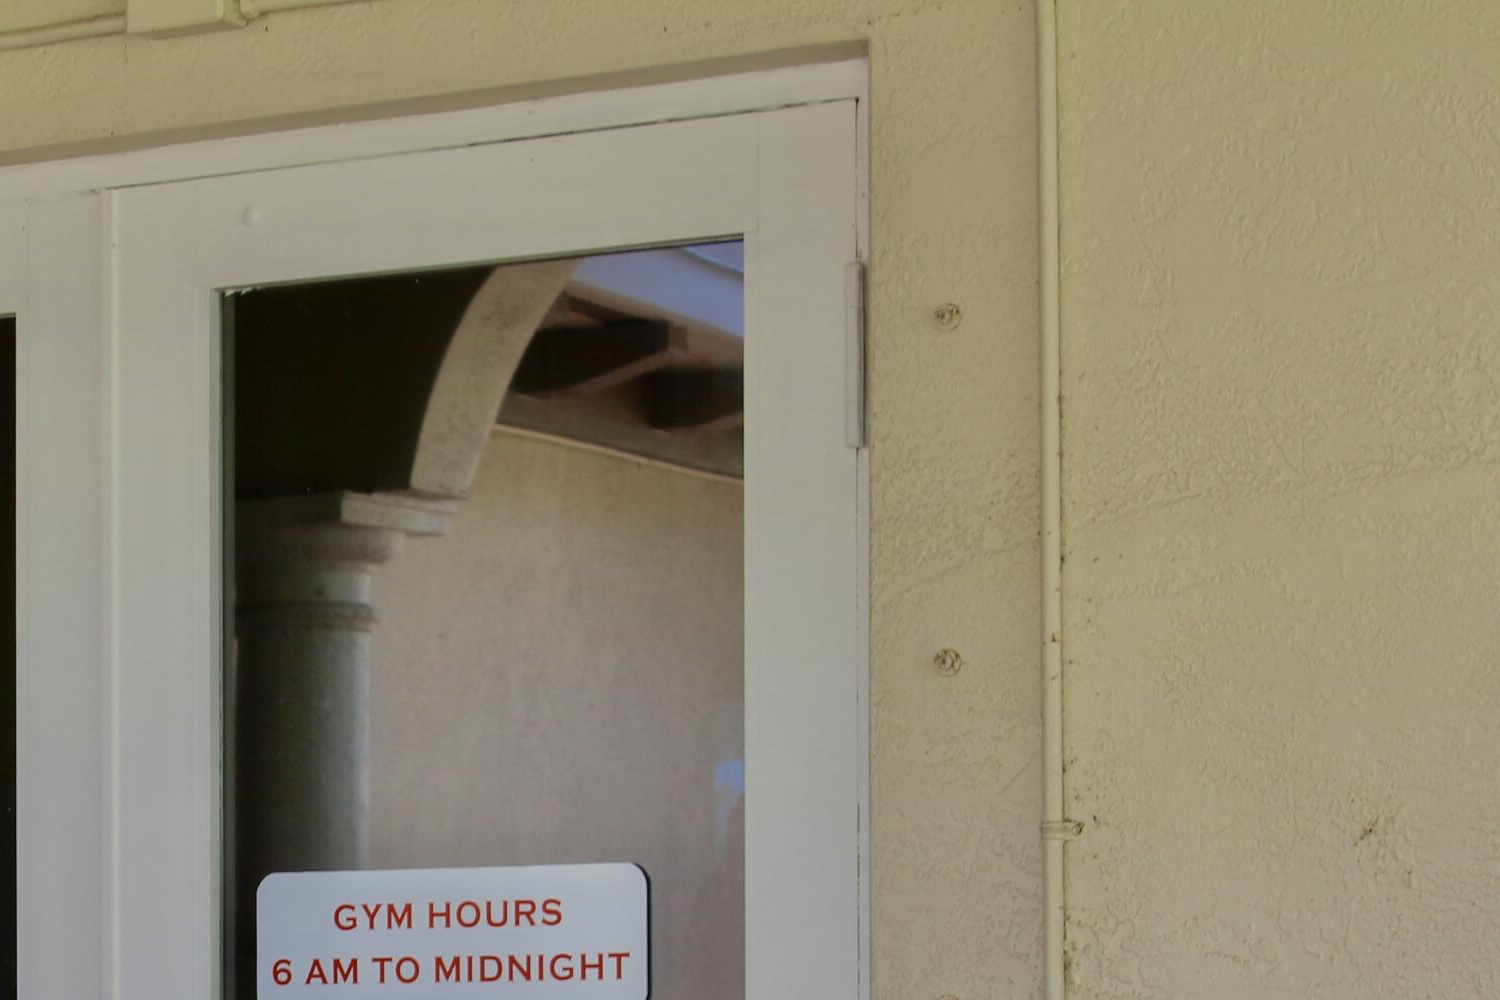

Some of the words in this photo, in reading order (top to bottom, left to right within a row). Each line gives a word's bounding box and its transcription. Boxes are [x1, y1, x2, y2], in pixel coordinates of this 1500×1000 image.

[333, 903, 414, 932] GYM
[427, 898, 563, 929] HOURS
[271, 958, 293, 986] 6
[304, 957, 359, 985] AM
[371, 955, 421, 984] TO
[434, 952, 630, 983] MIDNIGHT
